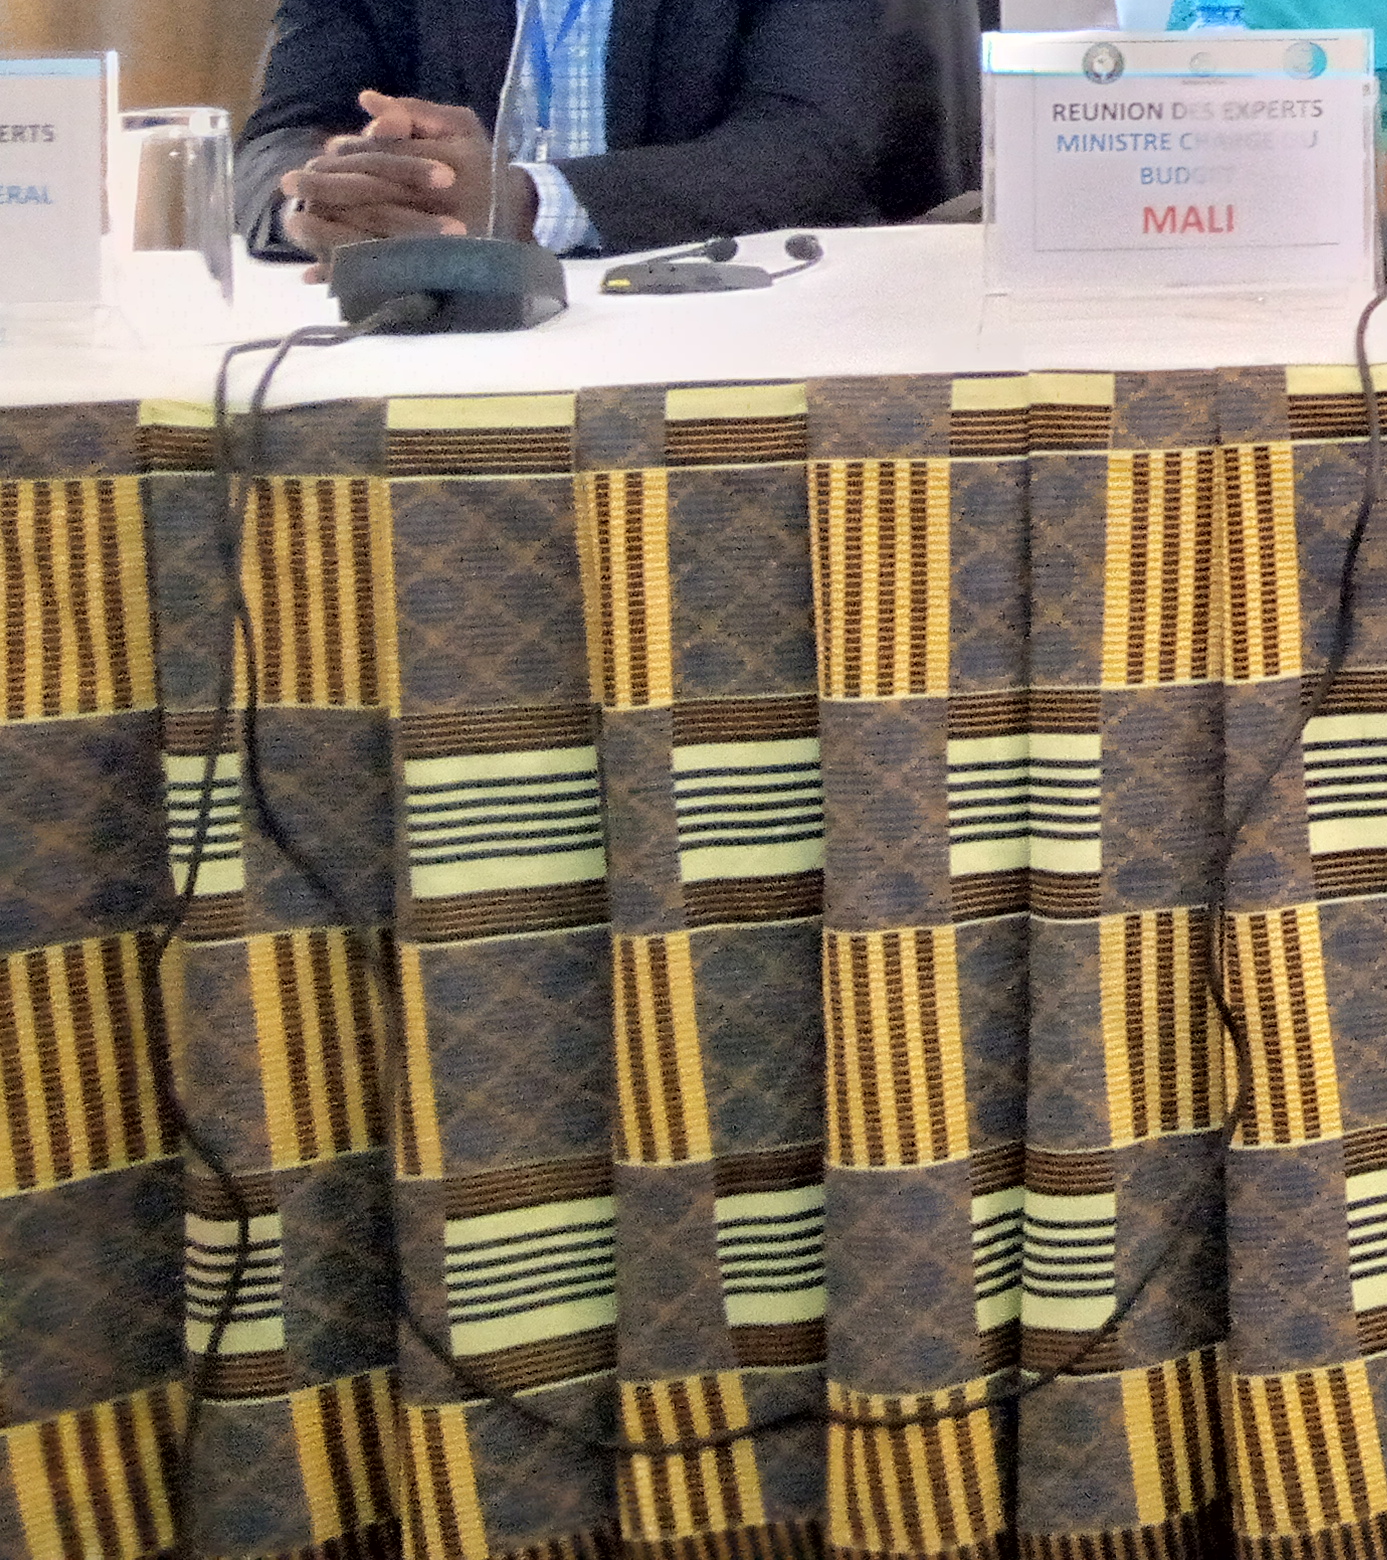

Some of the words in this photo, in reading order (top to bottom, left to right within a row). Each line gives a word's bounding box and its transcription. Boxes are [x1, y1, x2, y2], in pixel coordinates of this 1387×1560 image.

[1052, 102, 1163, 122] REUNION
[1172, 101, 1214, 121] DES
[1223, 99, 1323, 121] EXPERTS
[1056, 132, 1171, 153] MINISTRE
[1142, 204, 1235, 235] MALI
